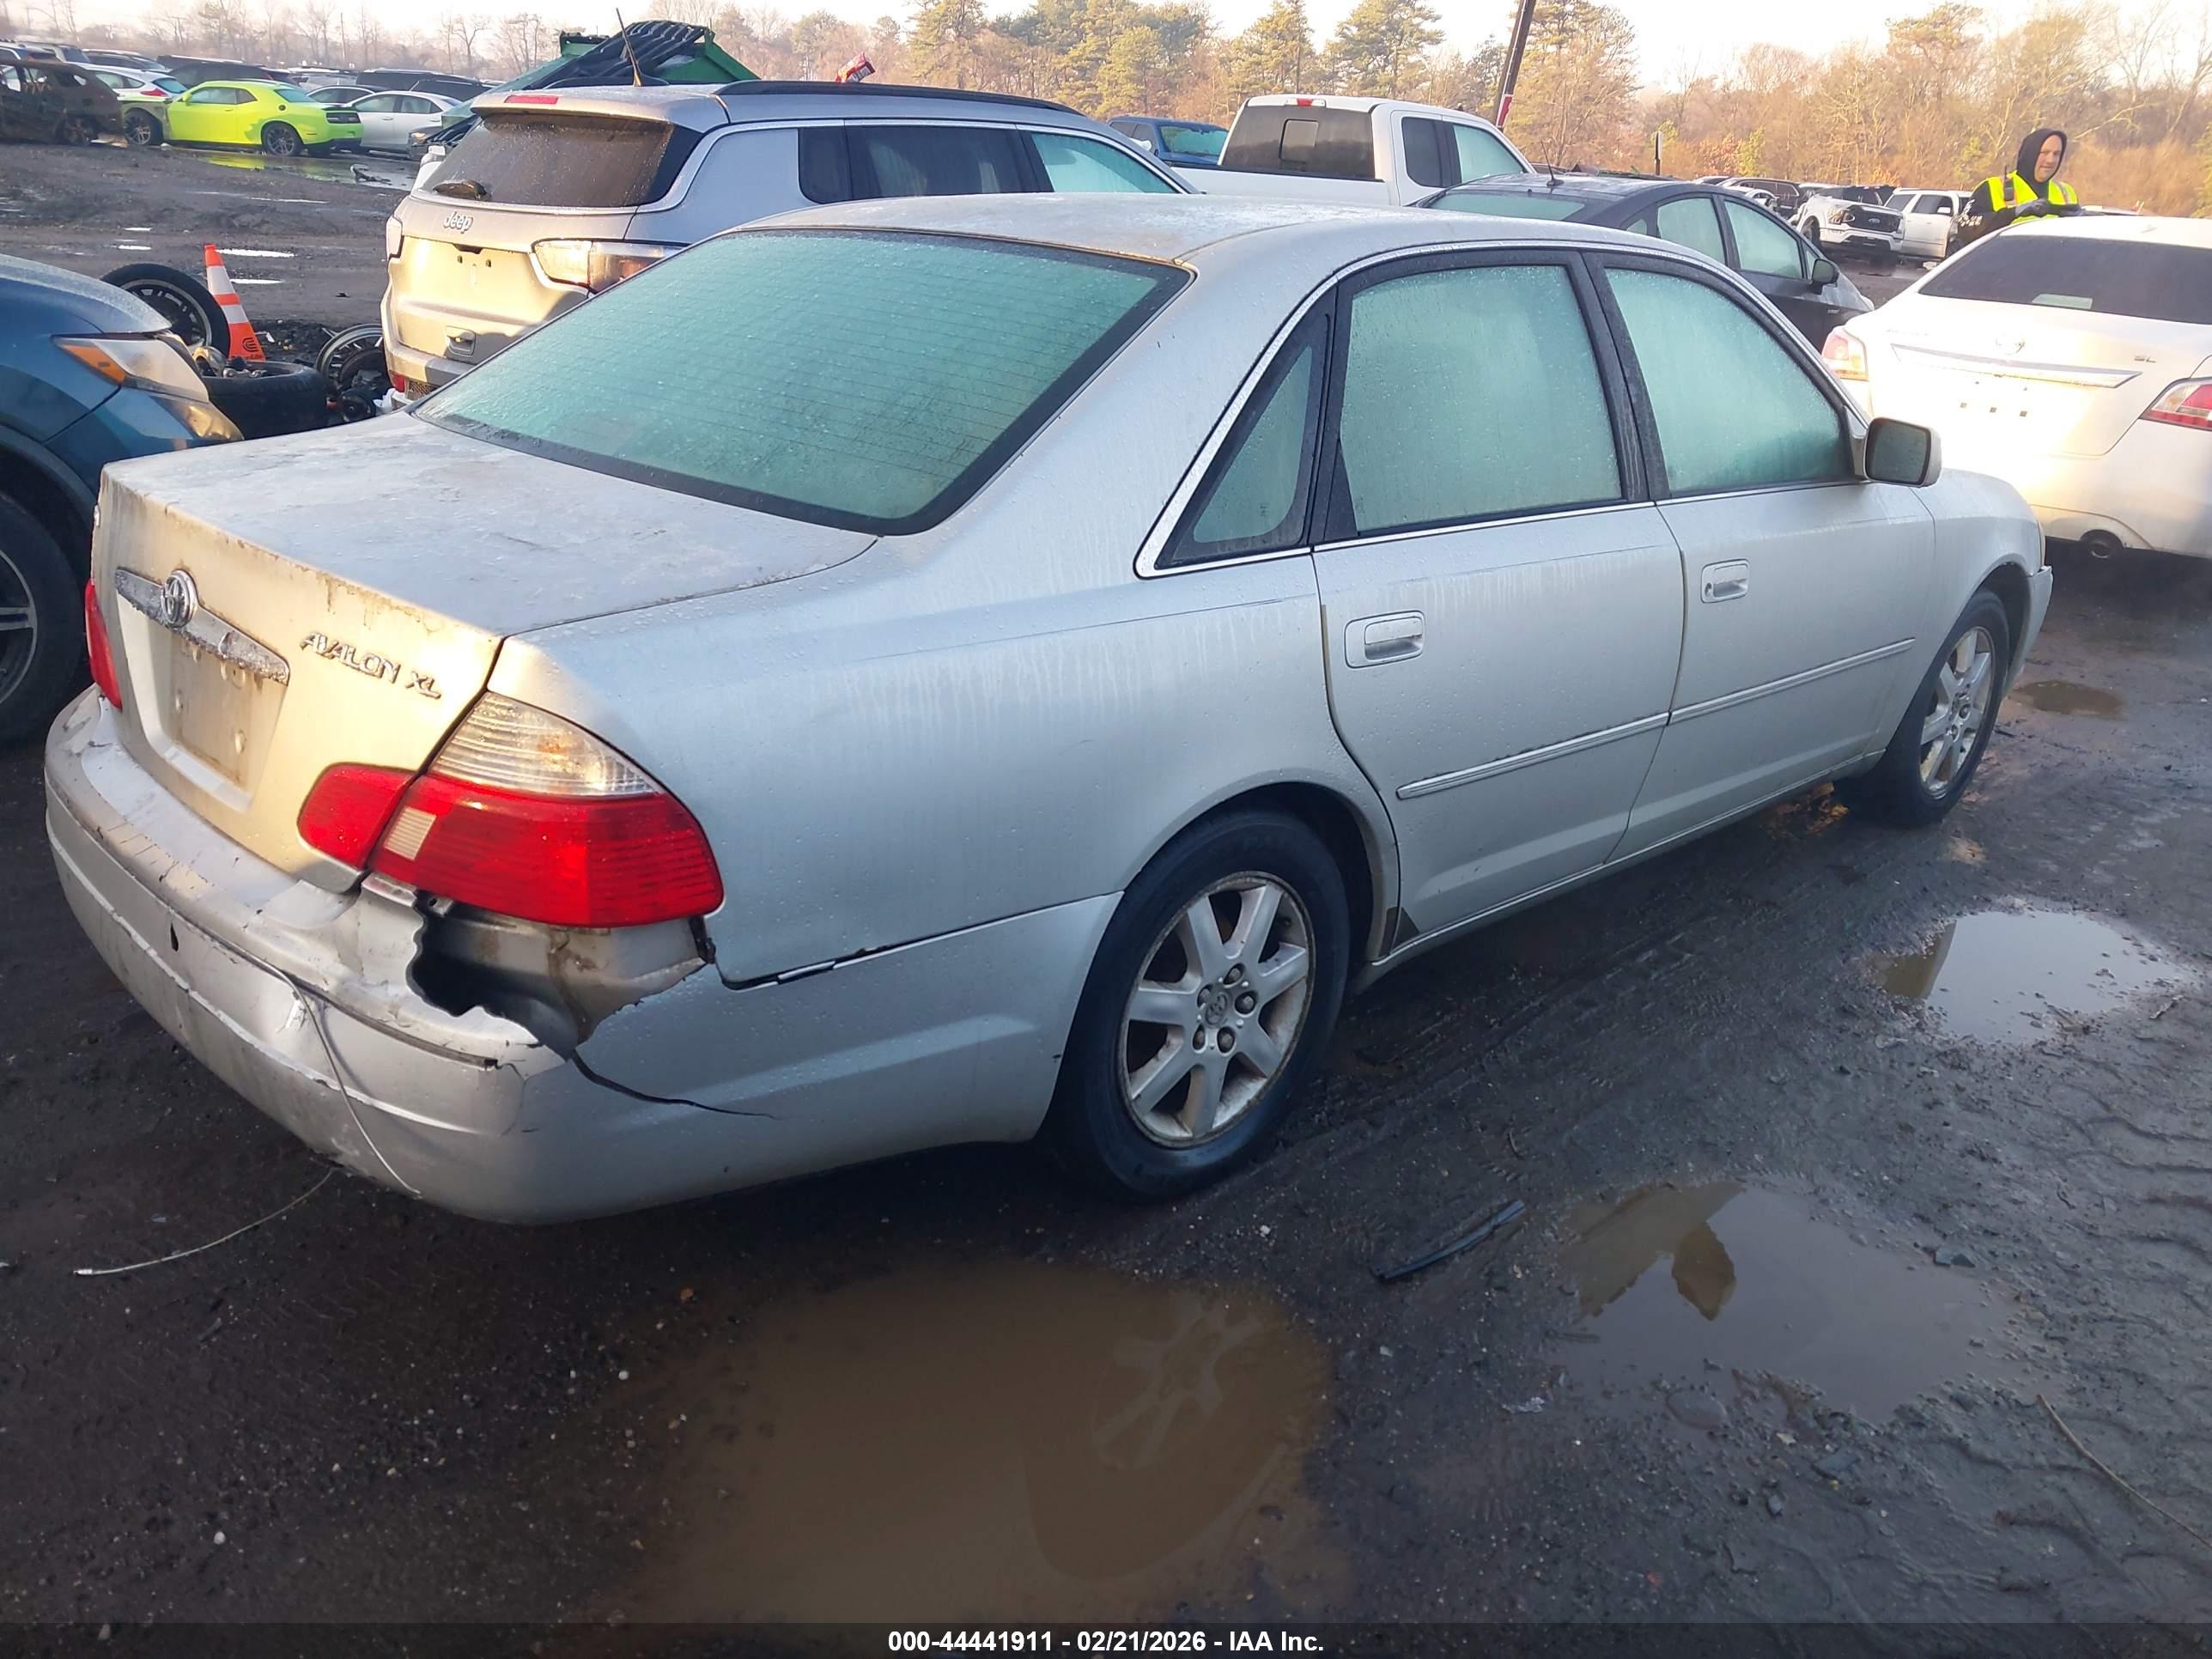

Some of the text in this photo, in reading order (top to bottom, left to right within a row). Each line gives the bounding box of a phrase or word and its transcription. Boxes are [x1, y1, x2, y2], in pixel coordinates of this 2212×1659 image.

[443, 210, 474, 234] Jeep
[300, 631, 442, 700] AVALON XL
